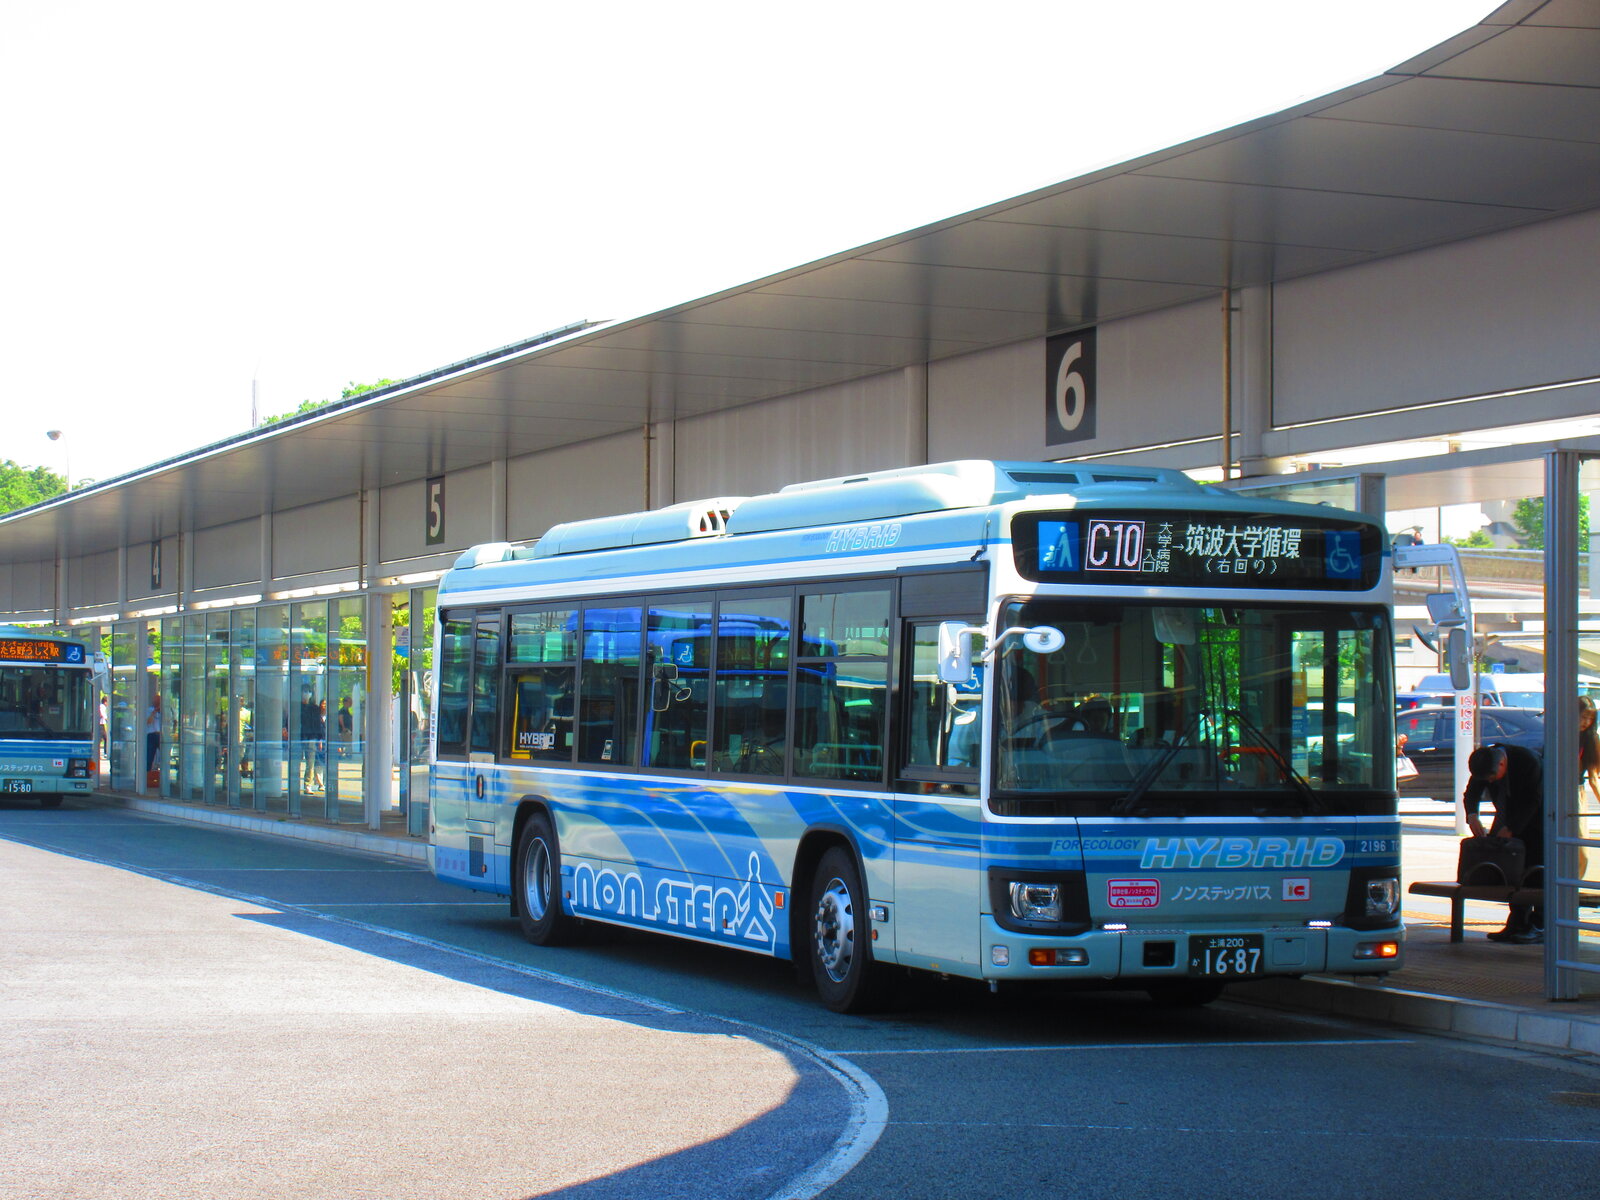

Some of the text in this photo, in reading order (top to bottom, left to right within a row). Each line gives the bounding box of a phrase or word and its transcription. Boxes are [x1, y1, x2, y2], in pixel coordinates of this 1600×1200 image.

[1056, 341, 1086, 431] 6
[430, 483, 441, 538] 5
[825, 523, 903, 553] HYBRID
[1089, 523, 1141, 567] C10
[1155, 522, 1173, 572] 大学病院
[1185, 524, 1302, 559] 筑波大学循環
[152, 544, 160, 585] 4
[1142, 549, 1156, 573] 入口
[1054, 839, 1141, 850] FOR ECOLOGY
[1140, 836, 1346, 869] HYBRID
[1361, 840, 1387, 852] 2196
[1171, 886, 1273, 901] ノンステップバス
